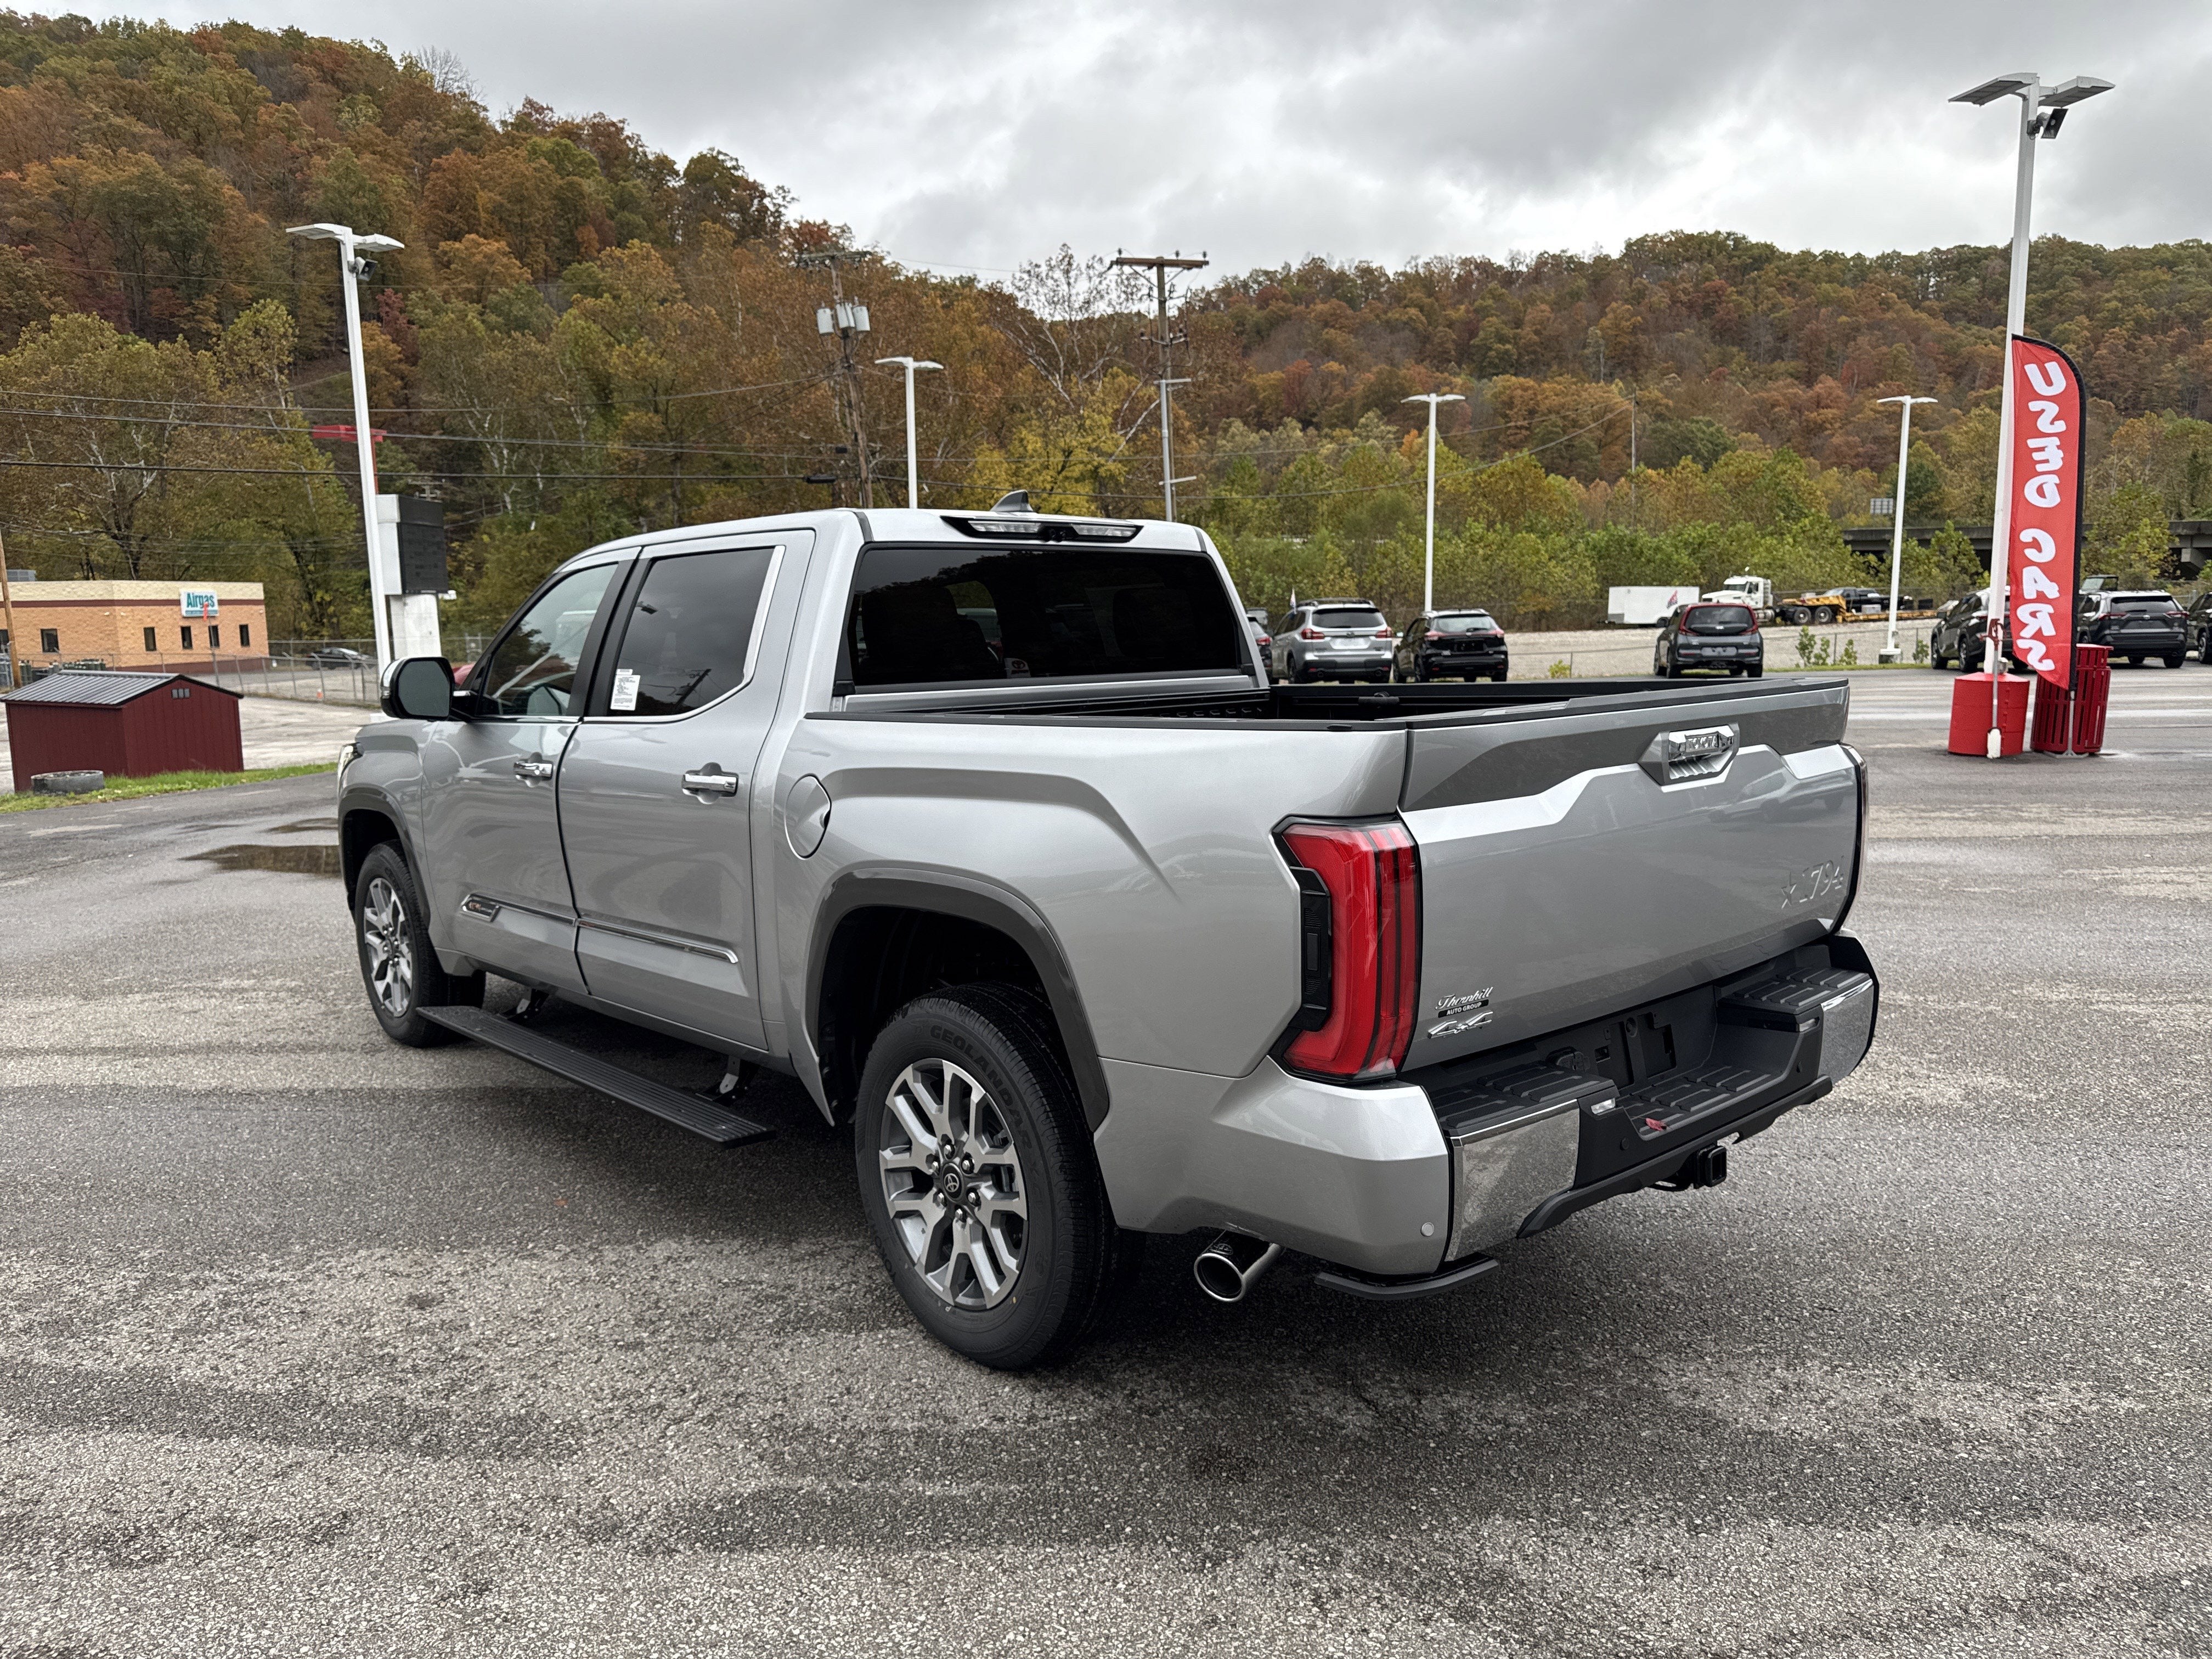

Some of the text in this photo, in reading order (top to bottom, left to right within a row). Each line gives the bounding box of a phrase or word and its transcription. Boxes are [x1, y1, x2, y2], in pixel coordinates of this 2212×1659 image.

[187, 592, 215, 608] Airgas
[1435, 986, 1493, 1010] Thornhill
[1446, 1002, 1482, 1015] AUTO GROUP
[930, 1025, 1032, 1149] GEOLANDAR
